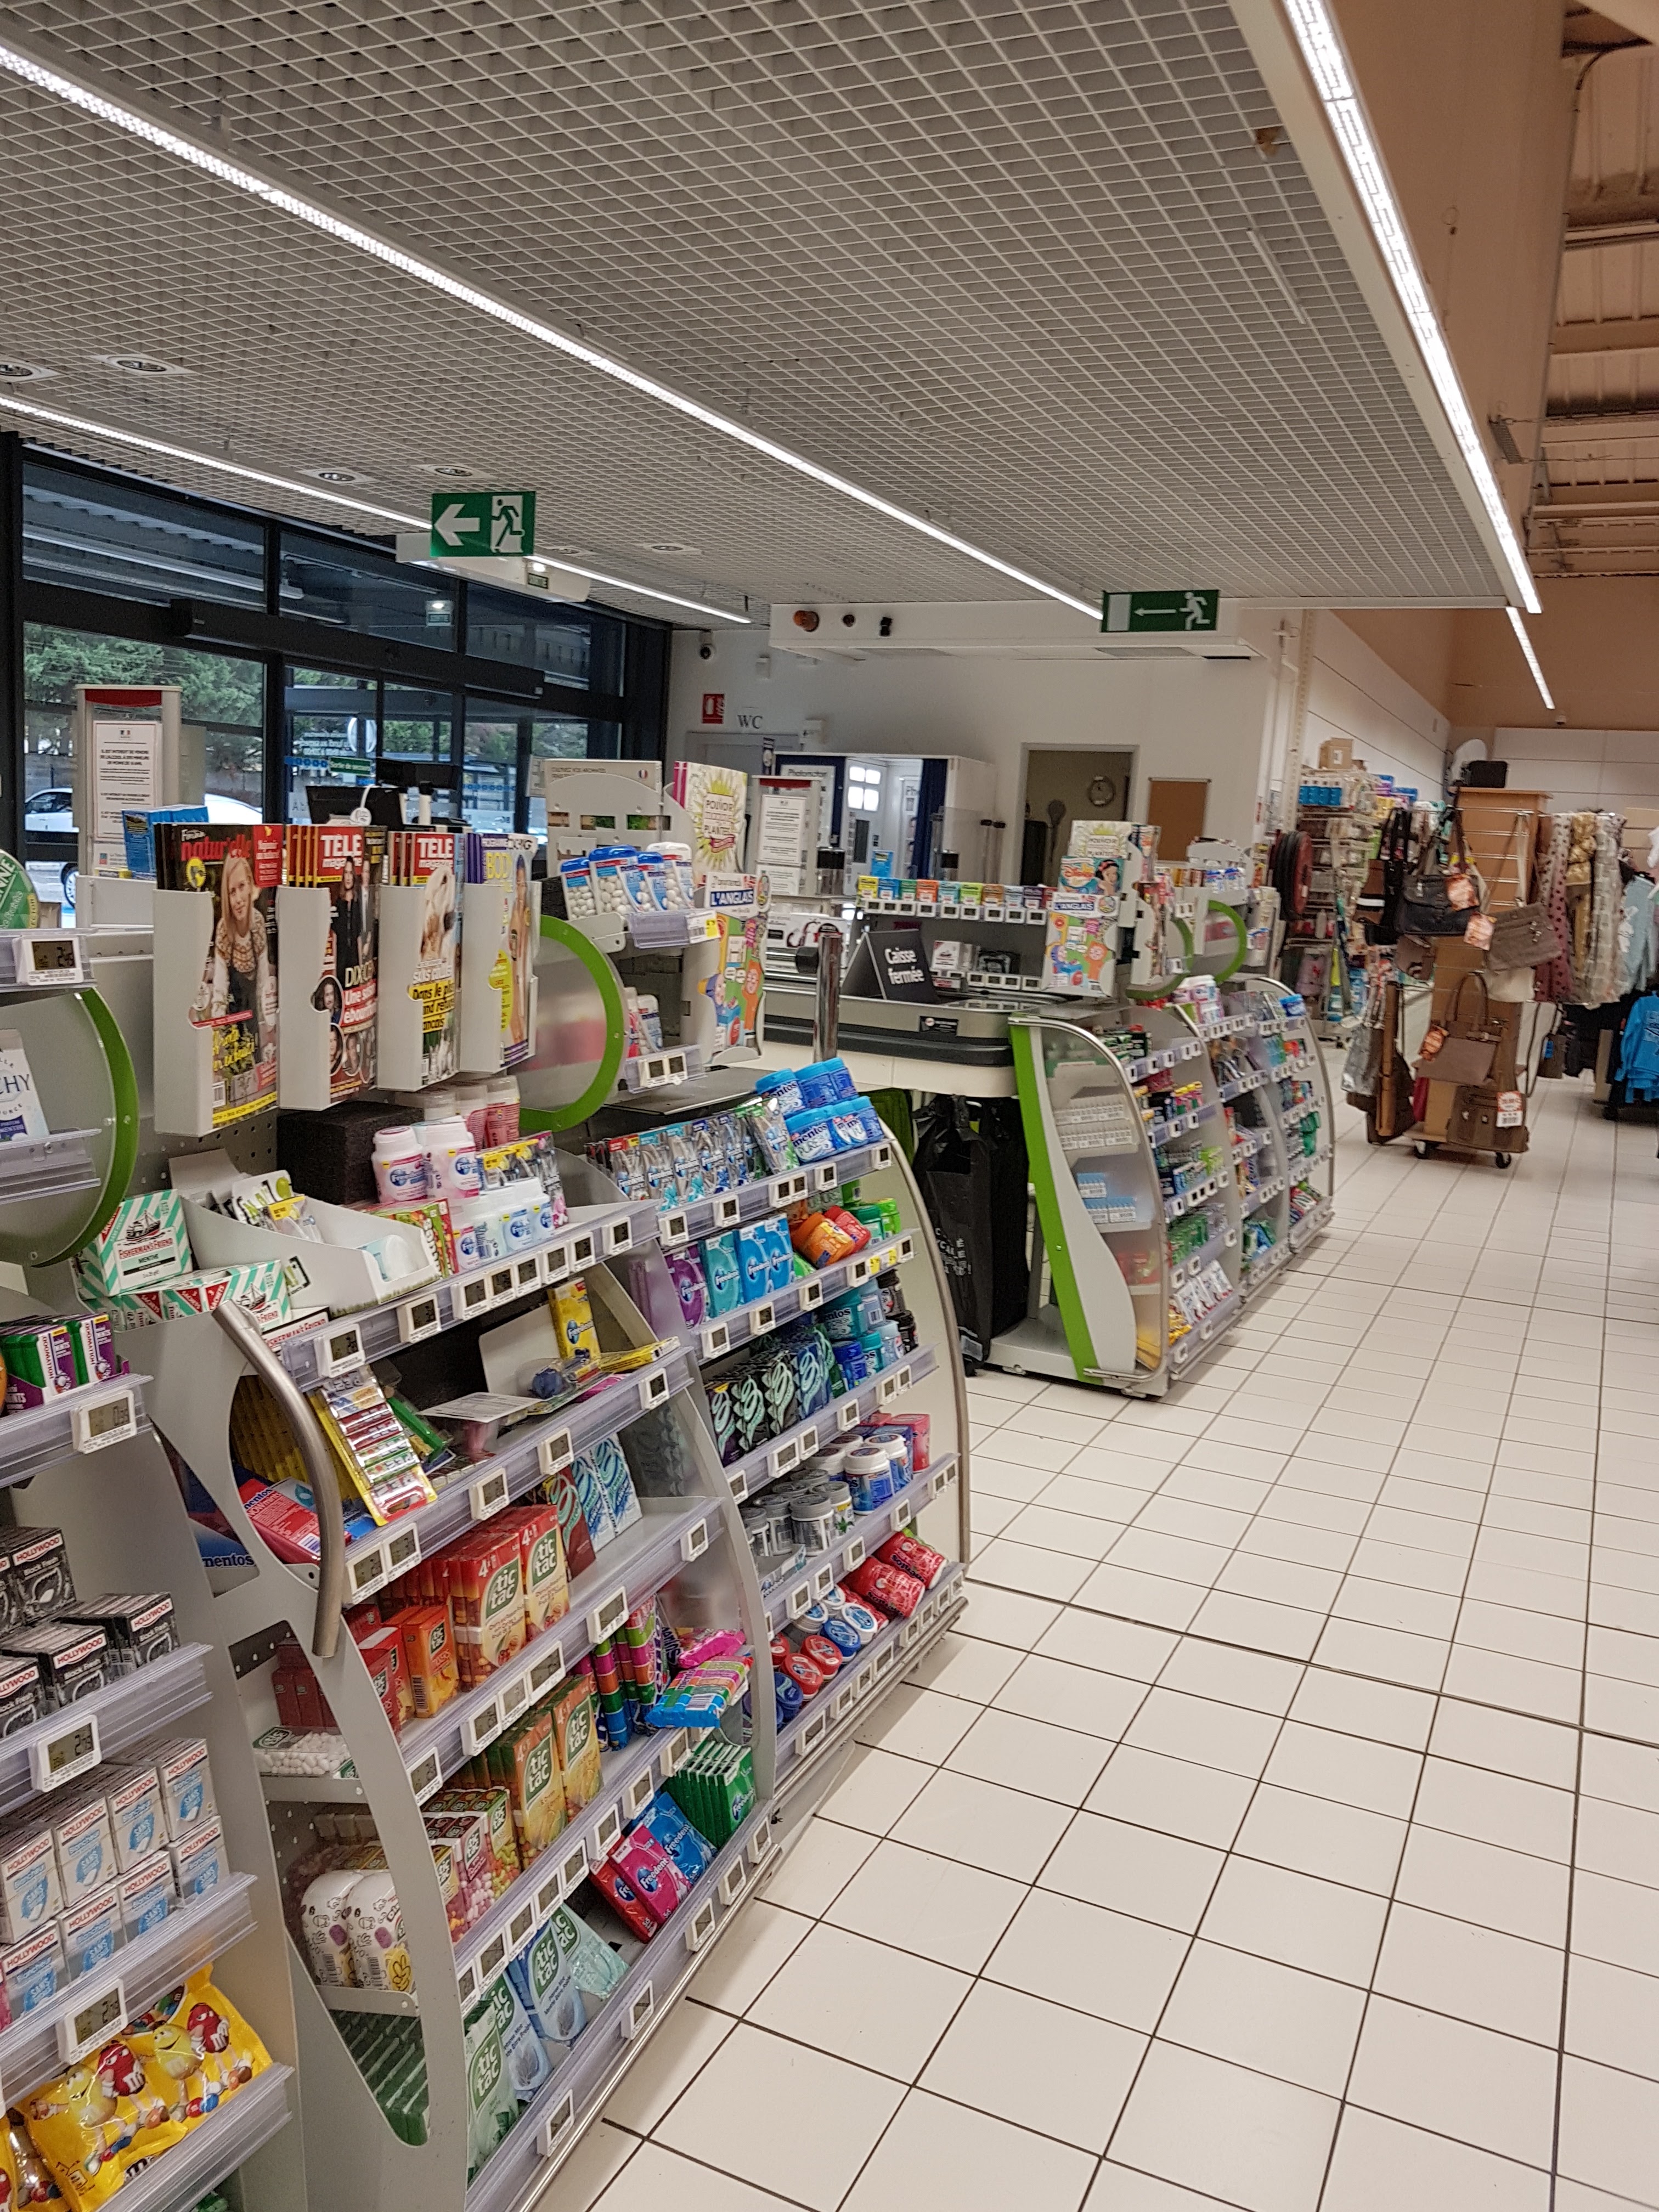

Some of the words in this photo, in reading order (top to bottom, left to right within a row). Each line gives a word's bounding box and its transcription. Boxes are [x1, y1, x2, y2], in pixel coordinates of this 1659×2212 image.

[737, 715, 763, 729] WC
[884, 946, 917, 964] Caisse
[887, 966, 925, 985] fermée
[768, 1081, 798, 1098] entos
[793, 1124, 827, 1147] mentos
[119, 1242, 154, 1260] FISHERMAN'S
[153, 1237, 173, 1249] FRIEND
[42, 1336, 55, 1380] HOLLYWOOD
[15, 1534, 61, 1563] HOLLYWOOD
[538, 1538, 554, 1559] tic
[533, 1554, 556, 1577] tac
[496, 1569, 515, 1591] tic
[490, 1583, 515, 1610] tac
[133, 1600, 172, 1629] HOLLYWOOD
[56, 1636, 104, 1667] HOLLYWOOD
[0, 1669, 36, 1695] LLYWOOD
[571, 1708, 587, 1731] tic
[567, 1727, 589, 1753] tac
[167, 1748, 205, 1776] HOLLYWOOD
[531, 1748, 549, 1770] tic
[115, 1776, 155, 1807] HOLLYWOOD
[527, 1765, 550, 1793] tac
[62, 1805, 104, 1838] HOLLYWOOD
[180, 1827, 218, 1857] HOLLYWOOD
[667, 1824, 691, 1855] Freedent
[8, 1837, 49, 1872] HOLLYWOOD
[124, 1863, 167, 1894] HOLLYWOOD
[640, 1856, 669, 1892] Freedent
[69, 1896, 114, 1929] HOLLYWOOD
[554, 1915, 567, 1935] ic
[6, 1933, 55, 1968] HOLLYWOOD
[536, 1937, 555, 1968] tic
[536, 1960, 558, 1989] tac
[494, 1988, 509, 2013] ic
[478, 2042, 498, 2072] tic
[476, 2064, 500, 2097] tac
